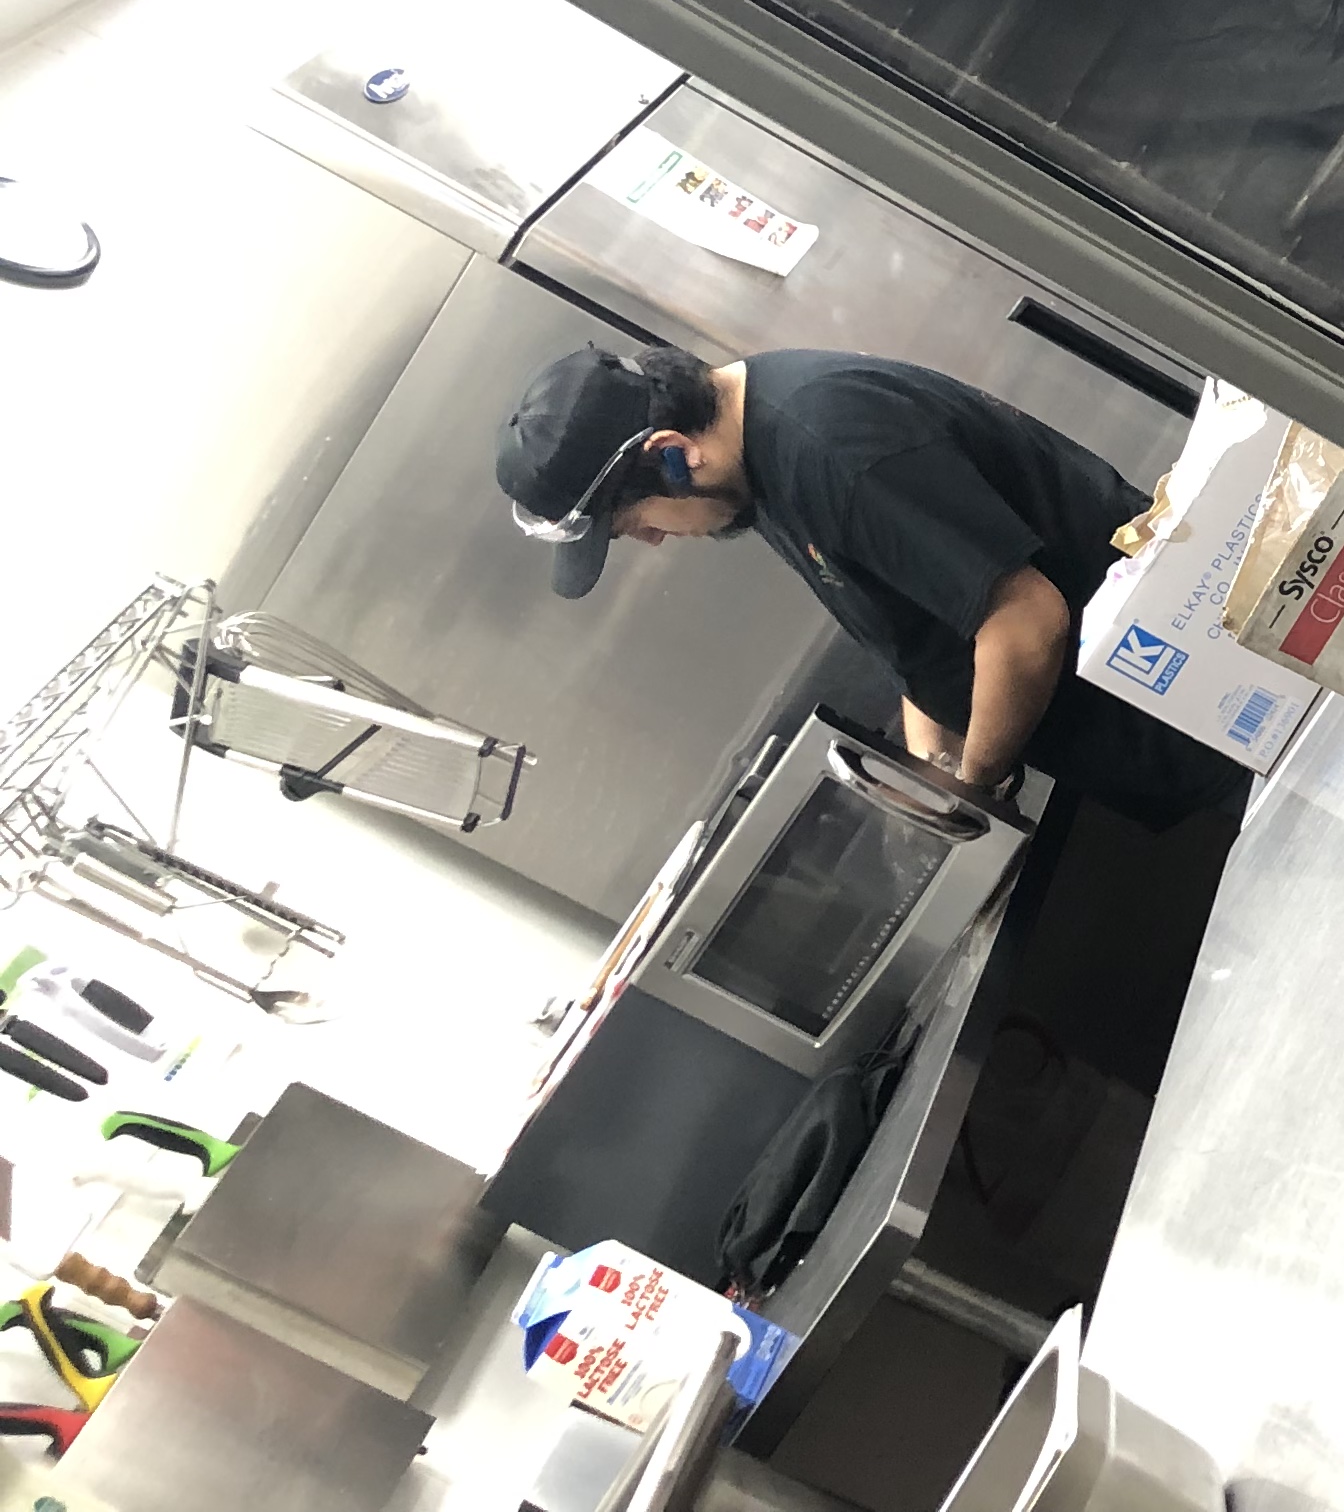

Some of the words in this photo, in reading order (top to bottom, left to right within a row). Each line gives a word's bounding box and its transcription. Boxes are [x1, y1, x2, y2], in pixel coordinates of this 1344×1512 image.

[1279, 537, 1333, 599] Sysco
[1154, 650, 1186, 693] PLASTICS
[622, 1275, 644, 1306] 100%
[626, 1269, 662, 1330] LACTOSE
[646, 1287, 668, 1320] FREE
[575, 1347, 603, 1378] 100%
[579, 1341, 624, 1398] LACTOSE
[598, 1360, 626, 1392] FREE
